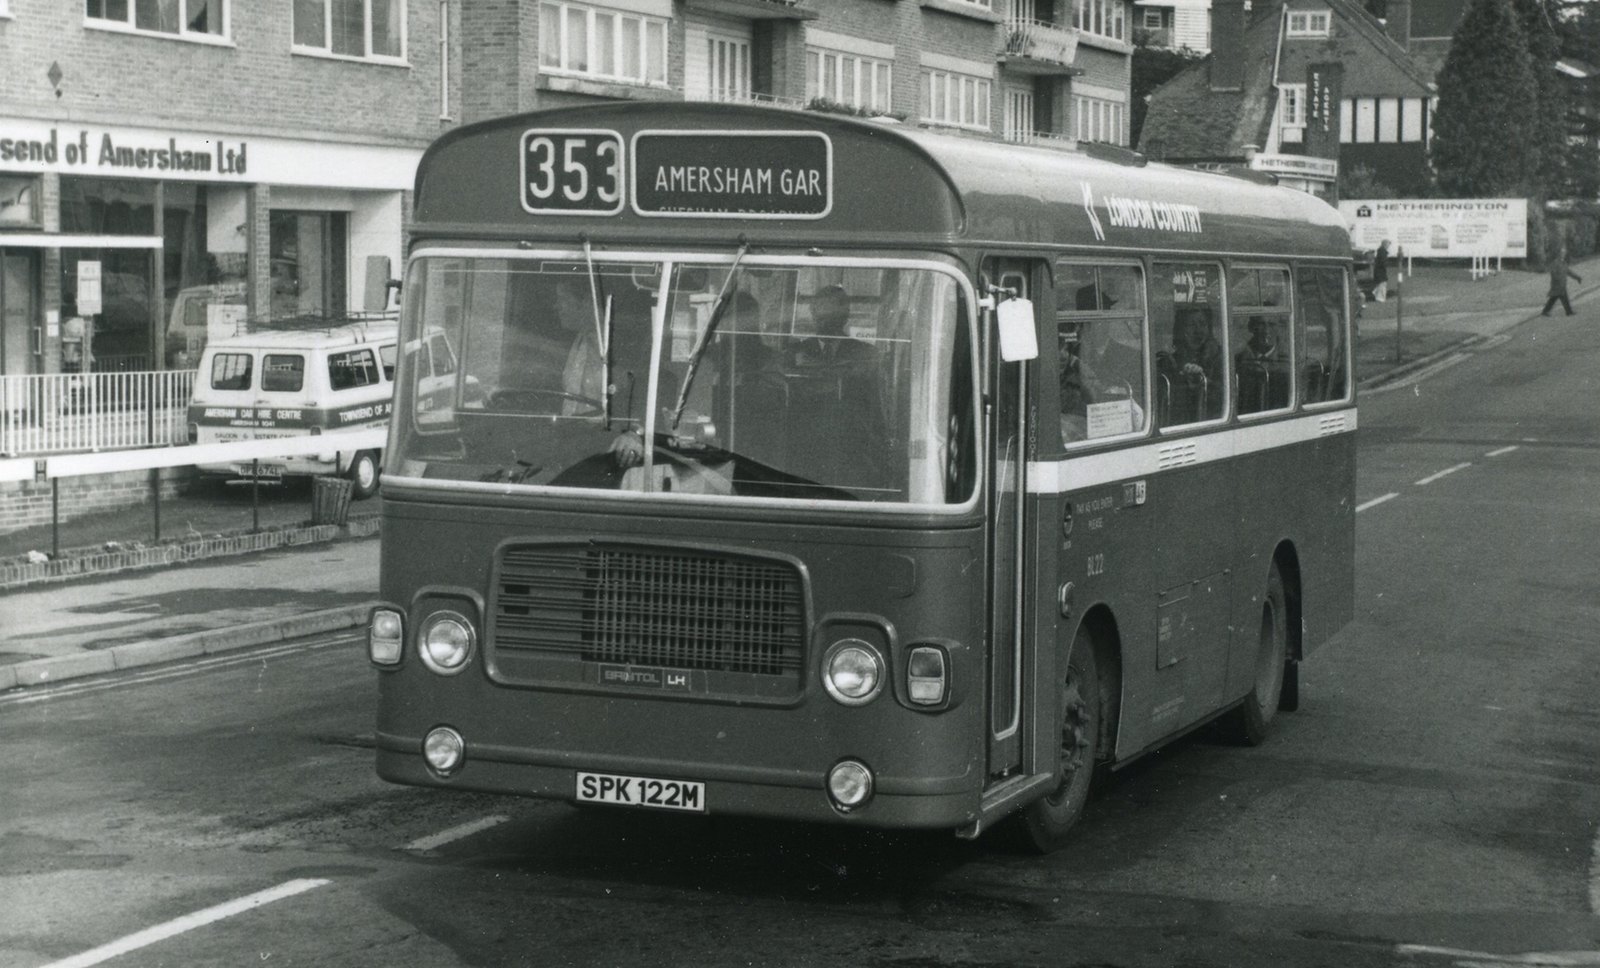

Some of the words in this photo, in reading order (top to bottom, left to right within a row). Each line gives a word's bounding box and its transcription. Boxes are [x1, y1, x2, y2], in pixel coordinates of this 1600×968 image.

[65, 130, 88, 165] of
[98, 132, 212, 171] Amersham
[217, 140, 247, 174] Ltd
[529, 137, 620, 202] 353
[655, 165, 772, 194] AMERSHAM
[780, 168, 822, 196] GAR
[1104, 195, 1155, 230] LONDON
[1152, 201, 1202, 233] COUNTRY
[1377, 203, 1508, 211] HETHERINGTON
[204, 408, 237, 418] AMERSHAM
[241, 409, 254, 418] CAR
[257, 409, 272, 419] HIRE
[277, 410, 302, 420] CENTRE
[339, 406, 373, 423] TOWNSEND
[374, 404, 383, 416] OF
[604, 670, 660, 684] BRISTOL
[667, 674, 685, 686] LH
[581, 775, 632, 802] SPK
[638, 780, 698, 808] 122M
